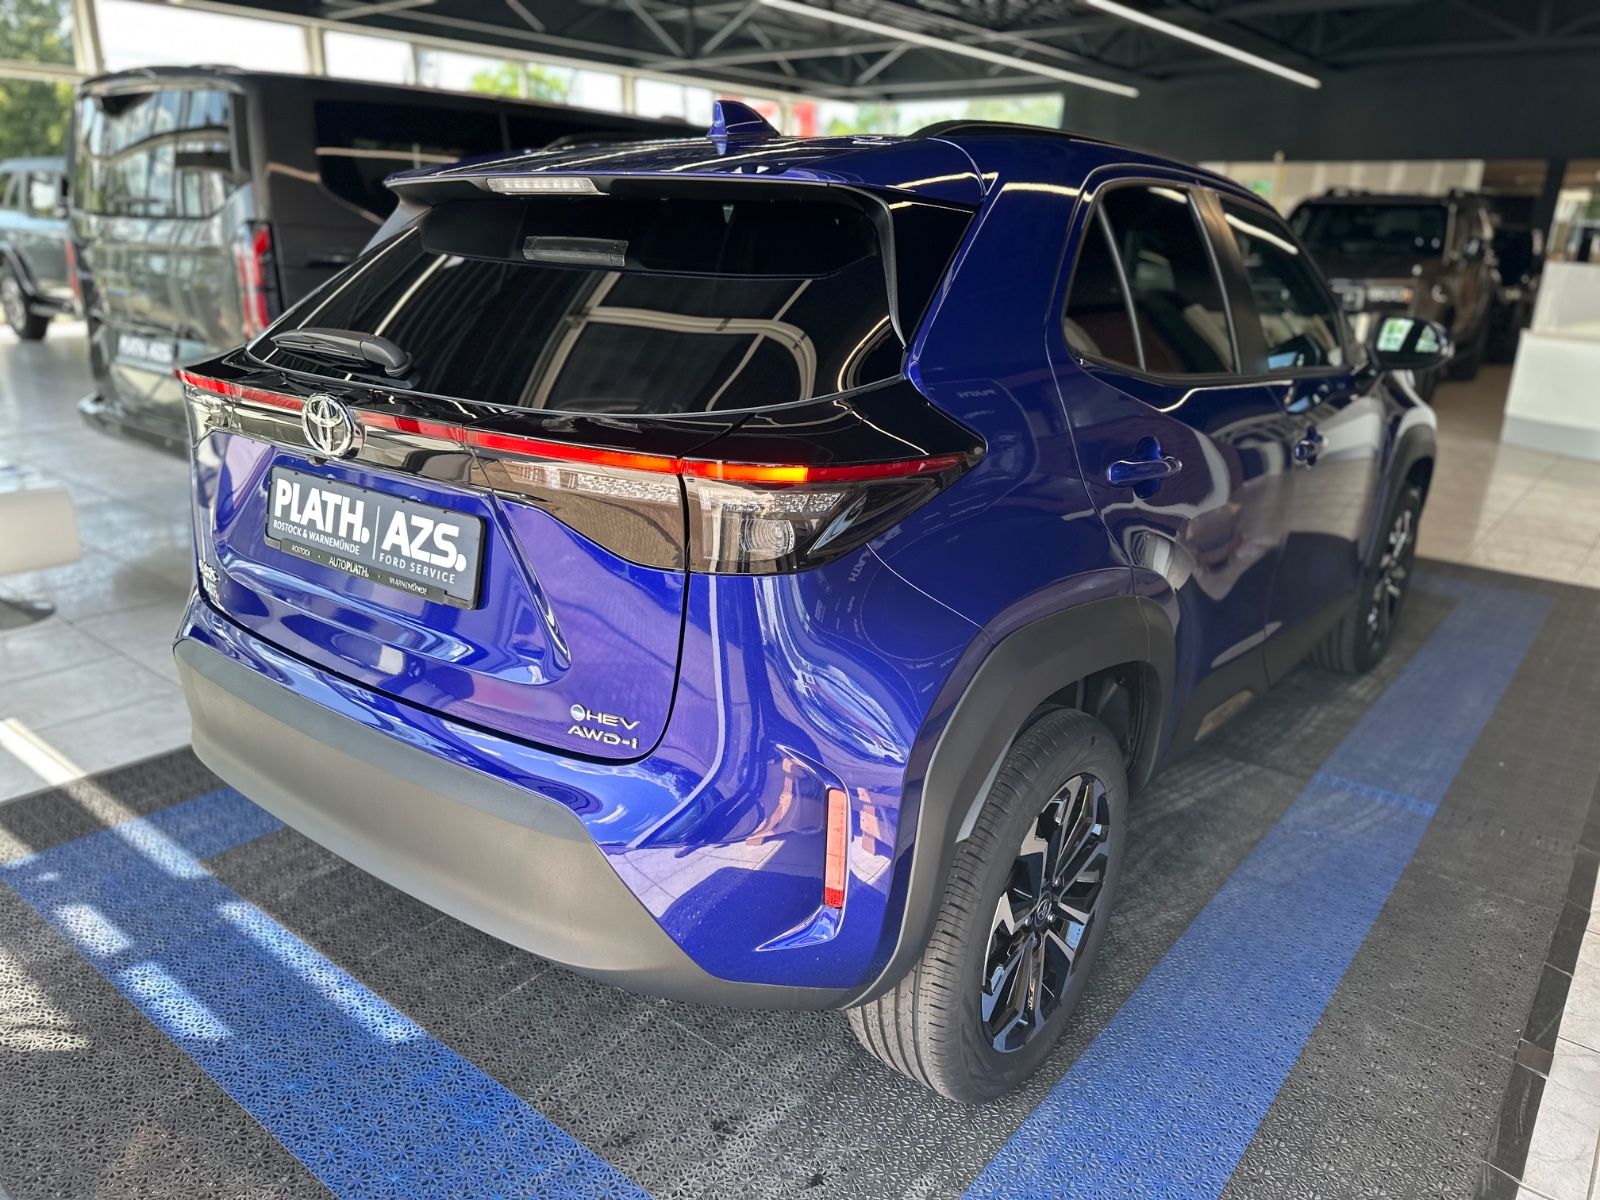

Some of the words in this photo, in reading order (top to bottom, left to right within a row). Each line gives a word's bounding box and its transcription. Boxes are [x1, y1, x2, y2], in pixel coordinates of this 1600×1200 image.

[274, 478, 370, 544] PLATH.
[273, 519, 302, 537] ROSTOCK
[302, 528, 308, 539] &
[309, 530, 360, 556] WARNEMÜNDE
[291, 544, 312, 557] ROSTOCK
[381, 510, 467, 572] AZS.
[379, 552, 406, 569] FORD
[409, 562, 456, 585] SERVICE
[586, 709, 640, 730] HEV
